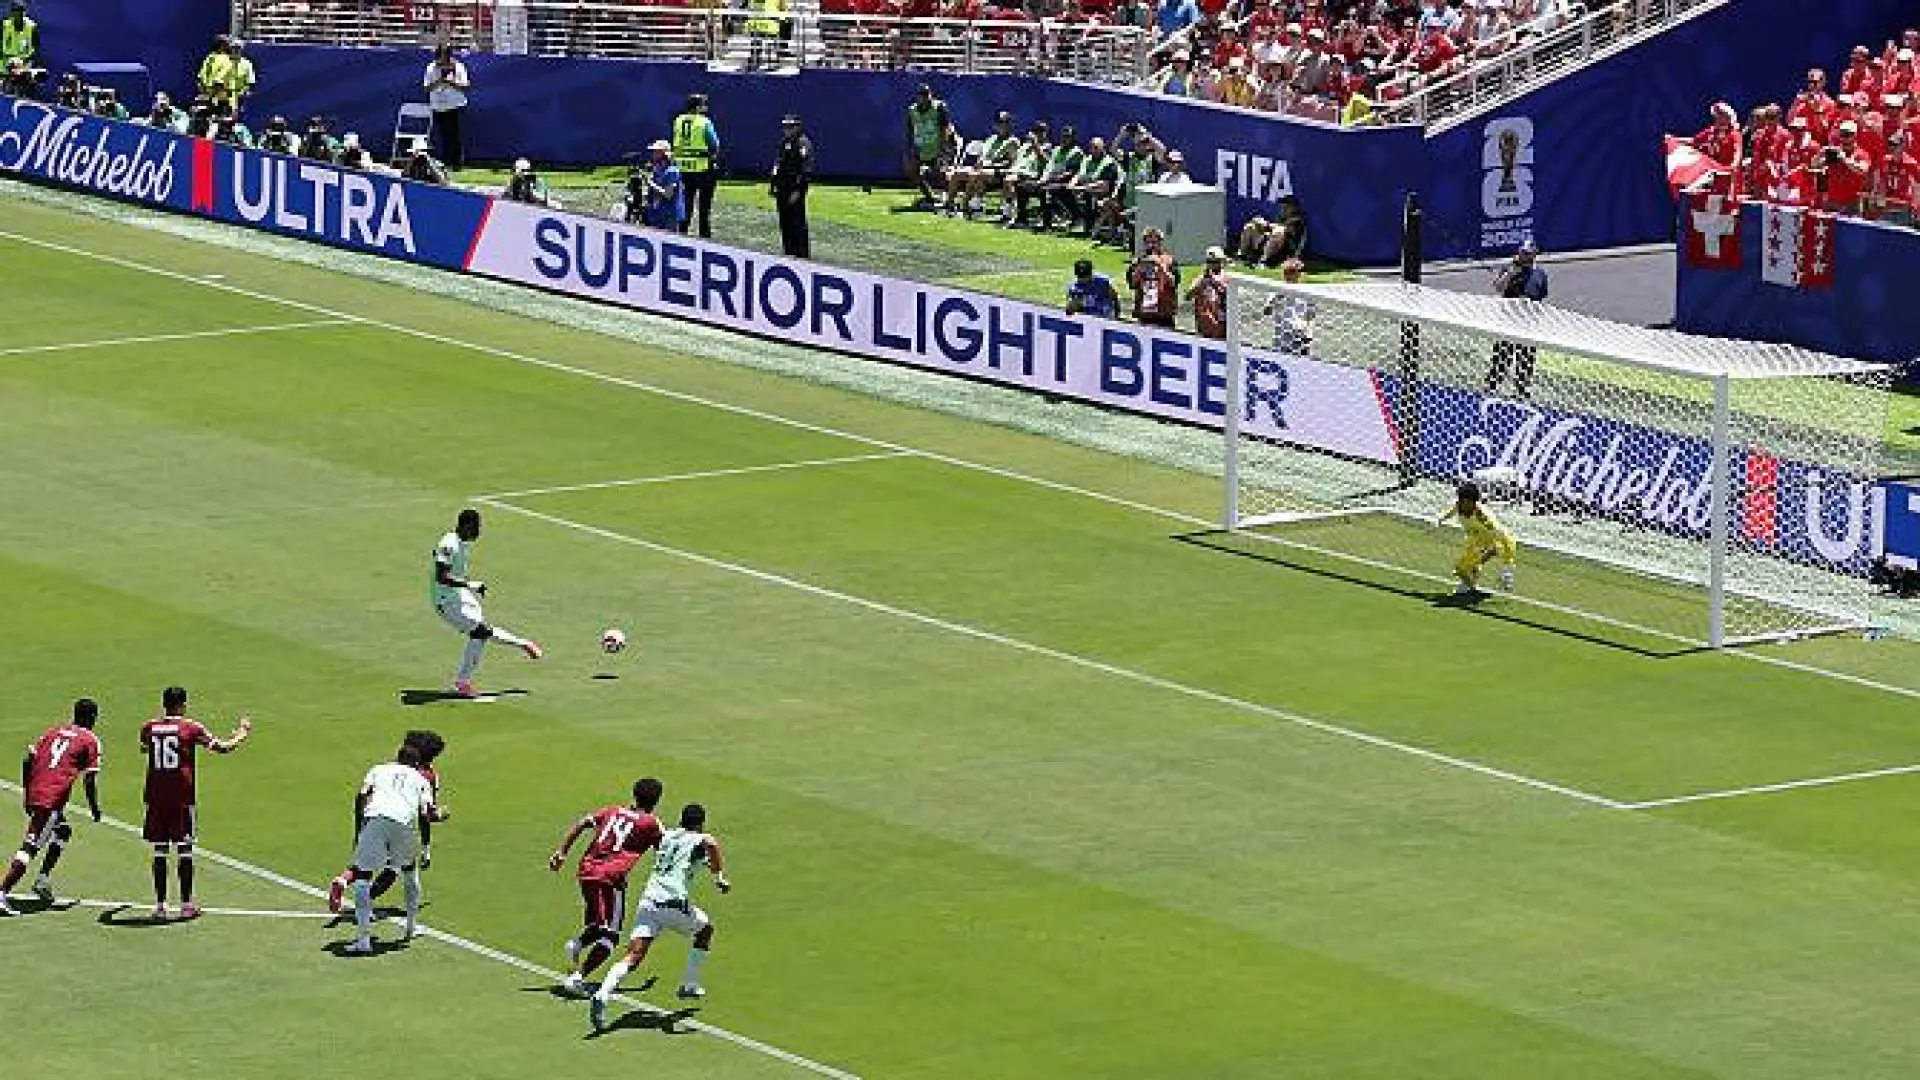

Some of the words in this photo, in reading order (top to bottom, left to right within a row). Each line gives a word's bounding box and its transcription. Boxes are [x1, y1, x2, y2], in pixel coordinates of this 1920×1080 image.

[0, 100, 178, 201] Michelob
[234, 151, 416, 254] ULTRA
[1217, 149, 1294, 203] FIFA
[533, 217, 854, 342] SUPERIOR
[873, 283, 1084, 383] LIGHT
[1100, 328, 1290, 430] BEER
[151, 735, 180, 769] 16
